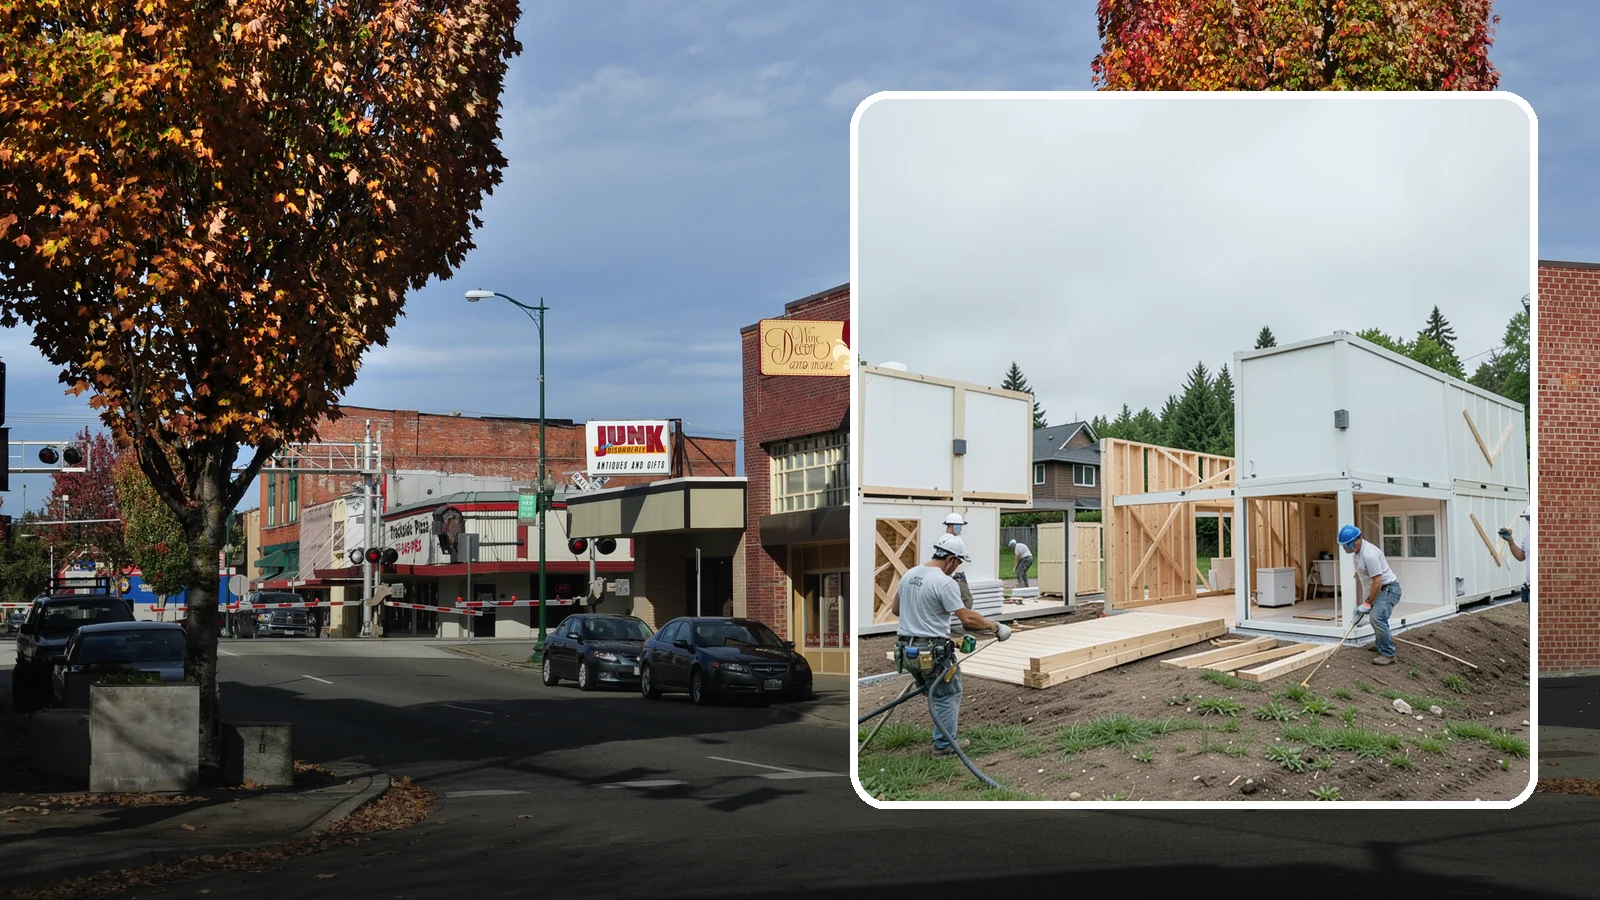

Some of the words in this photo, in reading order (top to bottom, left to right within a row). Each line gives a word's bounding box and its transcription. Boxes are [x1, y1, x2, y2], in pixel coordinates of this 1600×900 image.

[595, 425, 665, 457] JUNK
[607, 446, 646, 454] DISORDERLY
[597, 461, 627, 469] ANTIQUES
[631, 461, 644, 470] AND
[647, 460, 665, 470] GIFTS
[573, 473, 588, 491] RAIL
[390, 521, 412, 539] Trackside
[415, 520, 429, 534] Pizza
